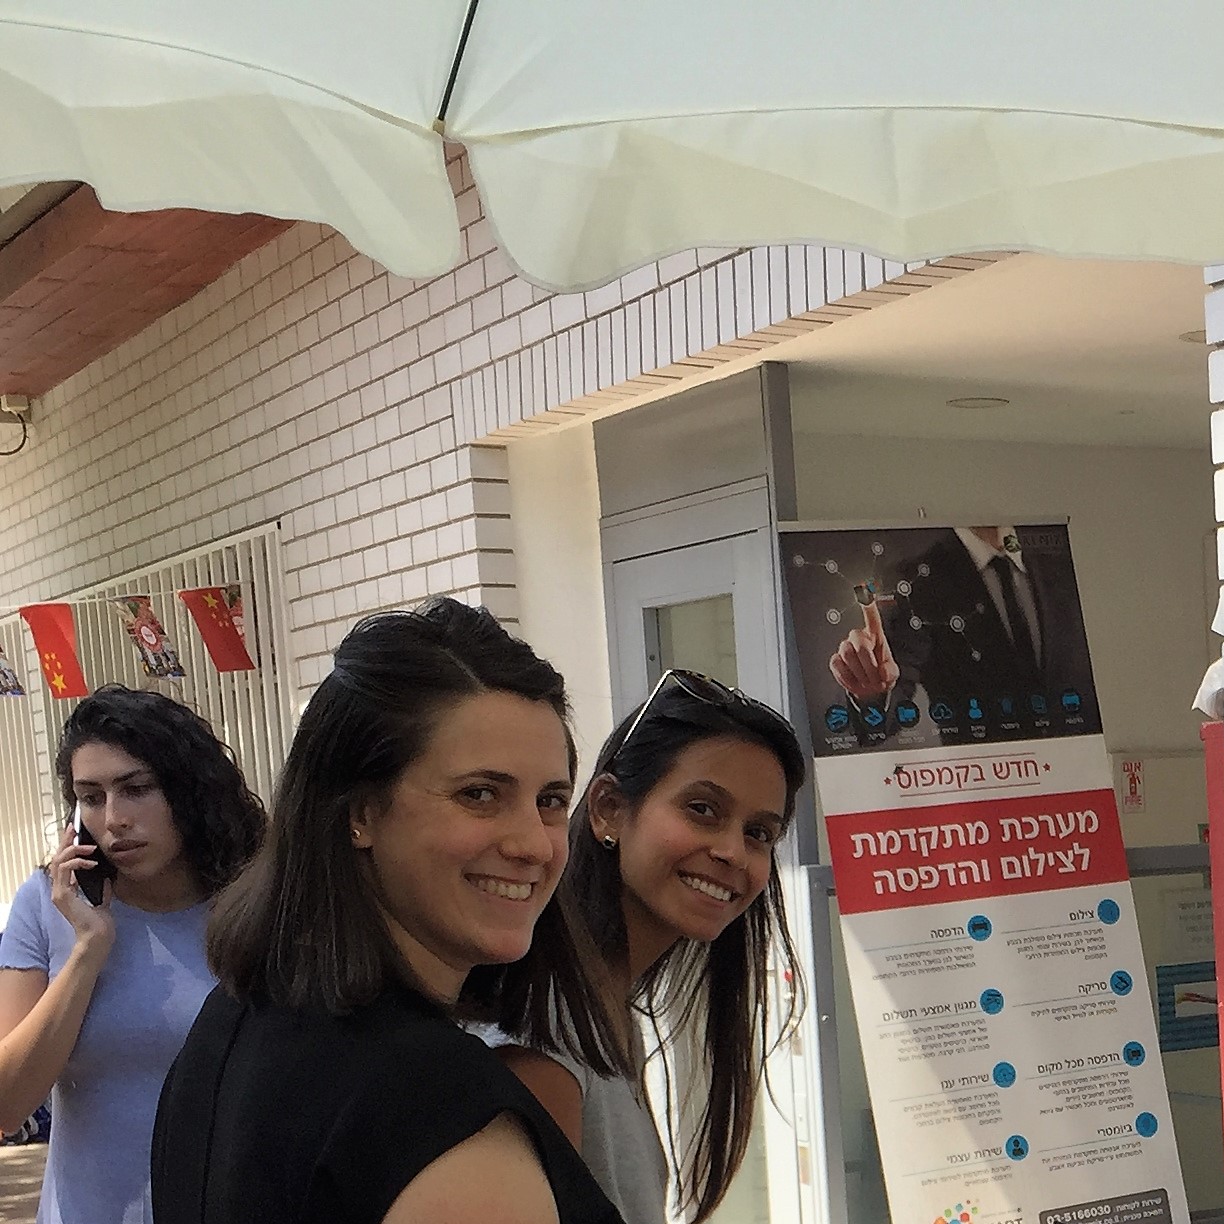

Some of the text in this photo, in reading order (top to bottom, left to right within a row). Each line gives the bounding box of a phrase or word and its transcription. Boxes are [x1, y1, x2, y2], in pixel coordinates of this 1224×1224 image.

[895, 758, 1039, 789] חדש בקמפוס
[850, 809, 1099, 859] מערכת מתקדמת
[873, 842, 1090, 895] לצילום והדפסה
[1069, 909, 1095, 921] צילום
[930, 926, 965, 939] הדפסה
[1078, 981, 1108, 994] סריקה
[882, 1008, 918, 1022] תשלום
[920, 1003, 952, 1017] אמצעי
[1037, 1052, 1120, 1075] הדפסה מכל מקום
[940, 1073, 990, 1090] שירותי ענן
[1097, 1123, 1133, 1137] ביומטרי
[946, 1146, 1003, 1164] שירות עצמי
